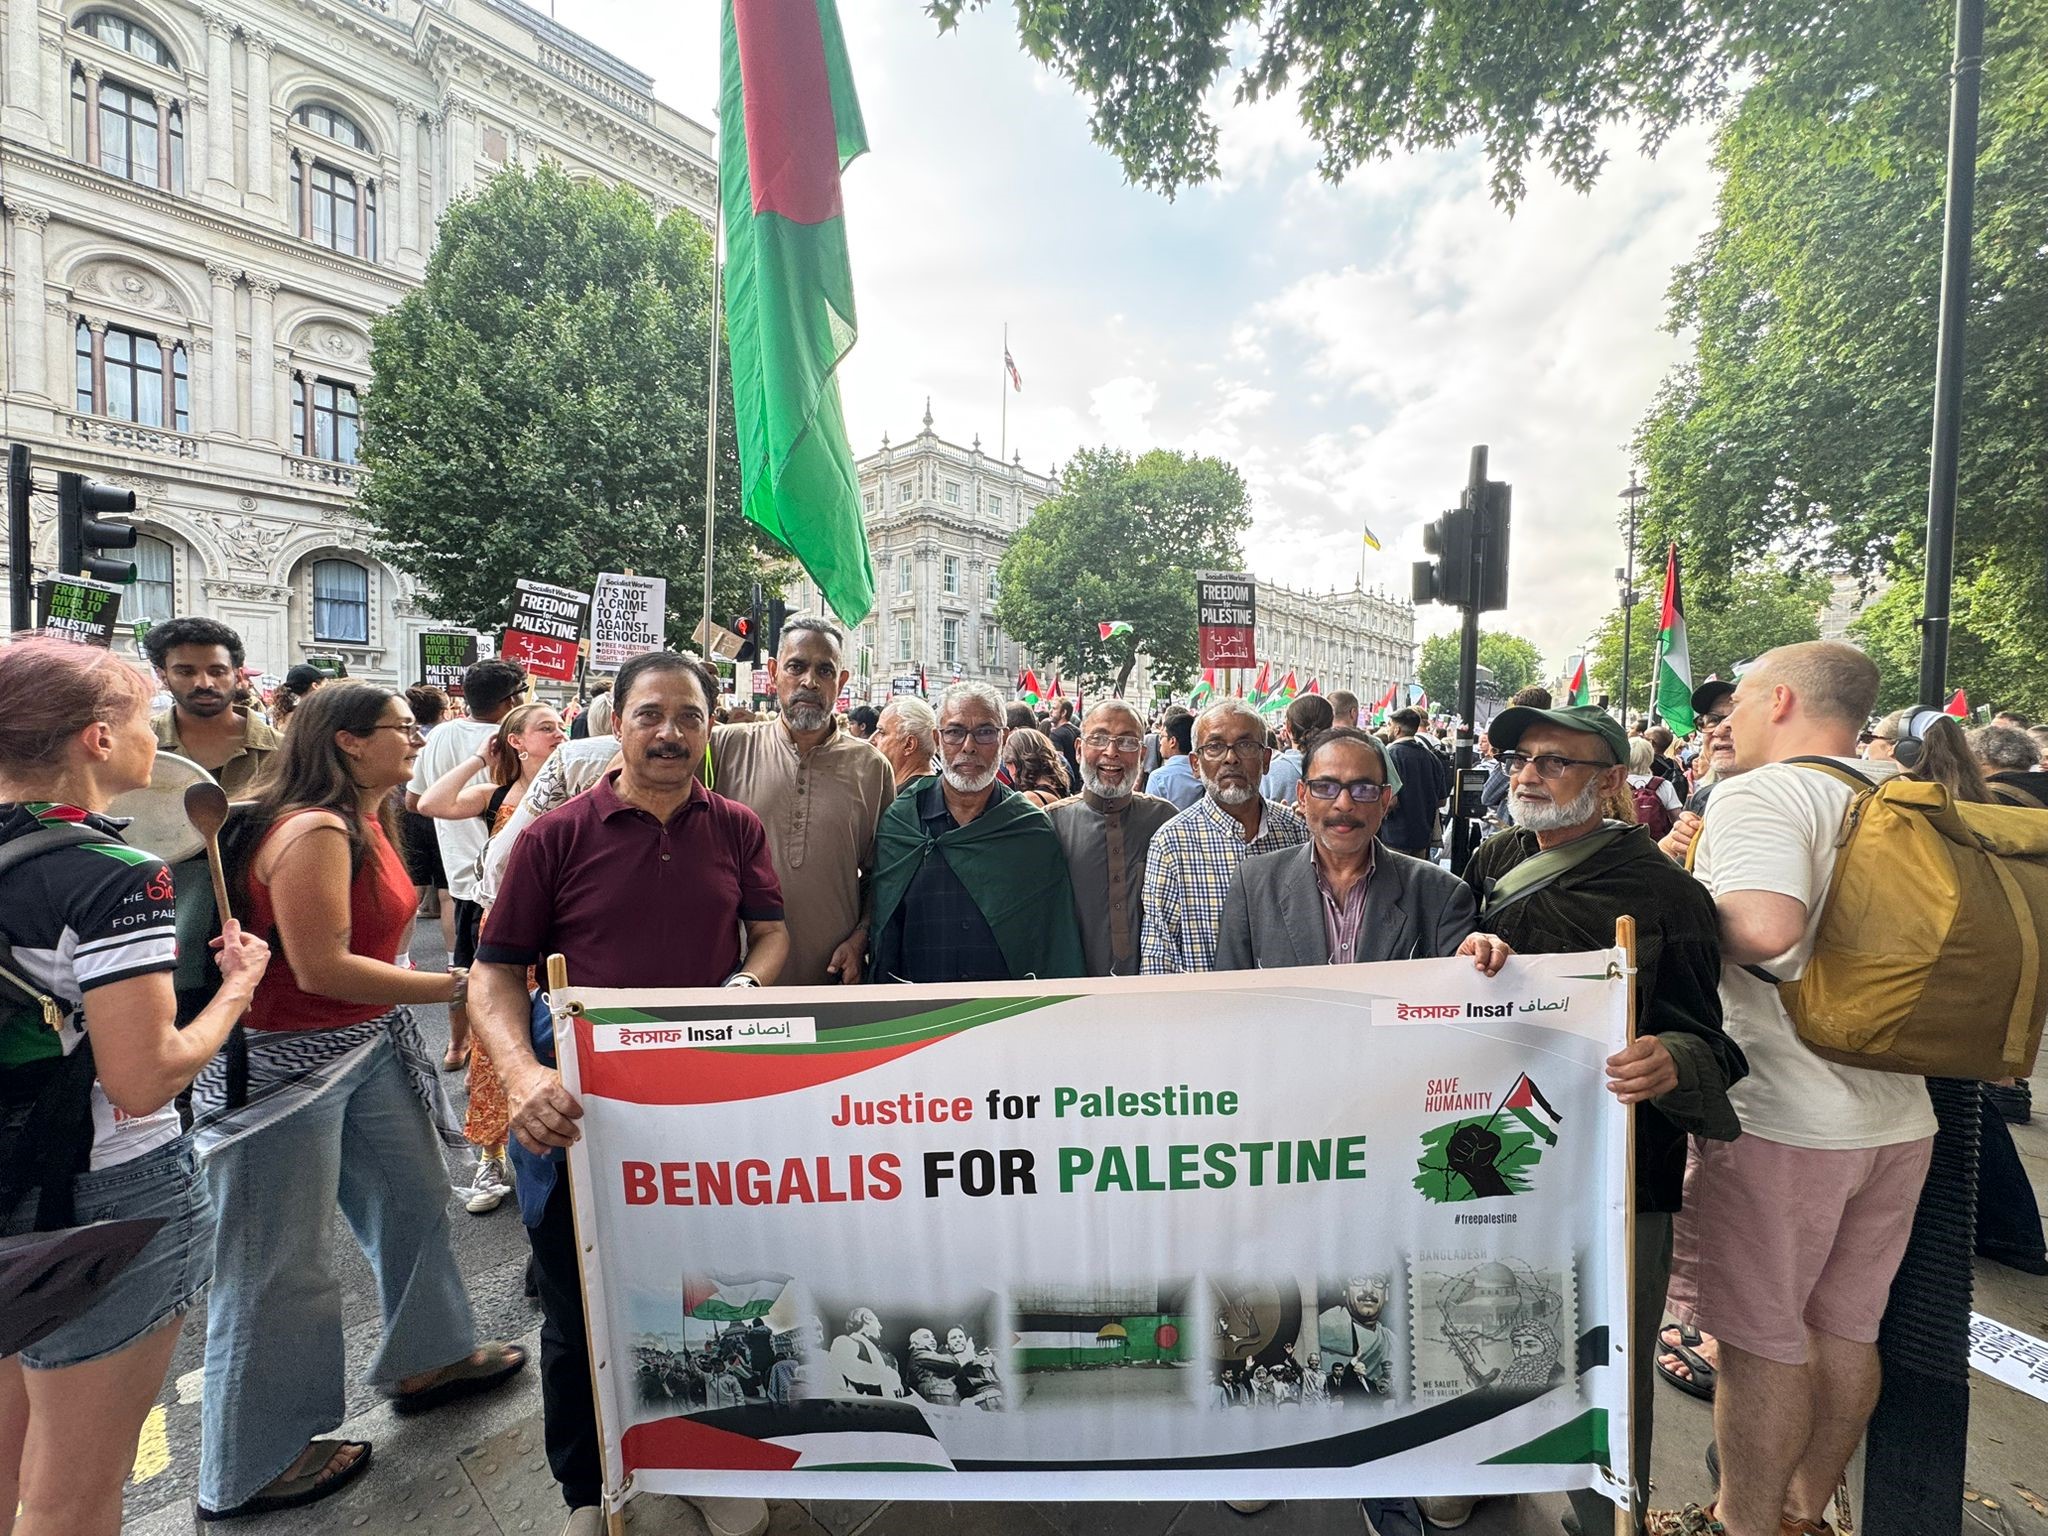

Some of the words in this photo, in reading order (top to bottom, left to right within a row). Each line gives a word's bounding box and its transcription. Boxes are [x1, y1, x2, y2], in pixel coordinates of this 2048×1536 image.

[527, 583, 555, 595] Socialist
[554, 588, 579, 601] Worker
[605, 579, 631, 587] Socialist
[630, 581, 653, 590] Worker
[54, 584, 85, 599] FROM
[88, 589, 111, 603] THE
[622, 588, 647, 601] NOT
[1203, 584, 1249, 602] FREEDOM
[51, 594, 83, 610] RIVER
[87, 600, 102, 613] TO
[520, 592, 580, 619] FREEDOM
[596, 597, 606, 608] A
[608, 598, 649, 612] CRIME
[50, 605, 71, 618] THE
[71, 608, 94, 623] SEA
[542, 612, 553, 620] for
[596, 607, 612, 619] TO
[614, 610, 638, 622] ACT
[1201, 608, 1252, 625] PALESTINE
[46, 615, 106, 636] PALESTINE
[512, 613, 579, 641] PALESTINE
[595, 618, 649, 633] AGAINST
[72, 629, 89, 643] BE
[424, 634, 449, 646] FROM
[452, 636, 470, 647] THE
[596, 629, 659, 645] GENOCIDE
[425, 644, 450, 655] RIVER
[453, 646, 465, 657] TO
[519, 636, 562, 655] الحرية
[601, 641, 617, 649] FREE
[617, 643, 651, 652] PALESTINE
[601, 648, 625, 657] DEFEND
[425, 654, 443, 665] THE
[443, 655, 462, 665] SEA
[425, 665, 470, 677] PALESTIN
[425, 674, 447, 686] WILL
[448, 675, 461, 686] BE
[111, 913, 147, 929] FOR
[1397, 1003, 1460, 1021] ইনসাফ
[1466, 1002, 1514, 1018] Insaf
[1519, 997, 1569, 1013] إنصاف
[619, 1028, 682, 1046] ইনসাফ
[687, 1025, 733, 1042] Insaf
[738, 1021, 790, 1038] إنصاف
[1427, 1077, 1459, 1096] SAVE
[831, 1092, 973, 1127] Justice
[986, 1089, 1040, 1120] for
[1054, 1084, 1239, 1118] Palestine
[1424, 1092, 1493, 1113] HUMANITY
[621, 1152, 903, 1206] BENGALIS
[923, 1148, 1038, 1199] FOR
[1058, 1135, 1367, 1194] PALESTINE
[1454, 1213, 1518, 1225] #freepalestine
[1419, 1248, 1488, 1262] BANGLADESH
[1423, 1380, 1434, 1389] WE
[1434, 1380, 1459, 1389] SALUTE
[1423, 1390, 1436, 1398] THE
